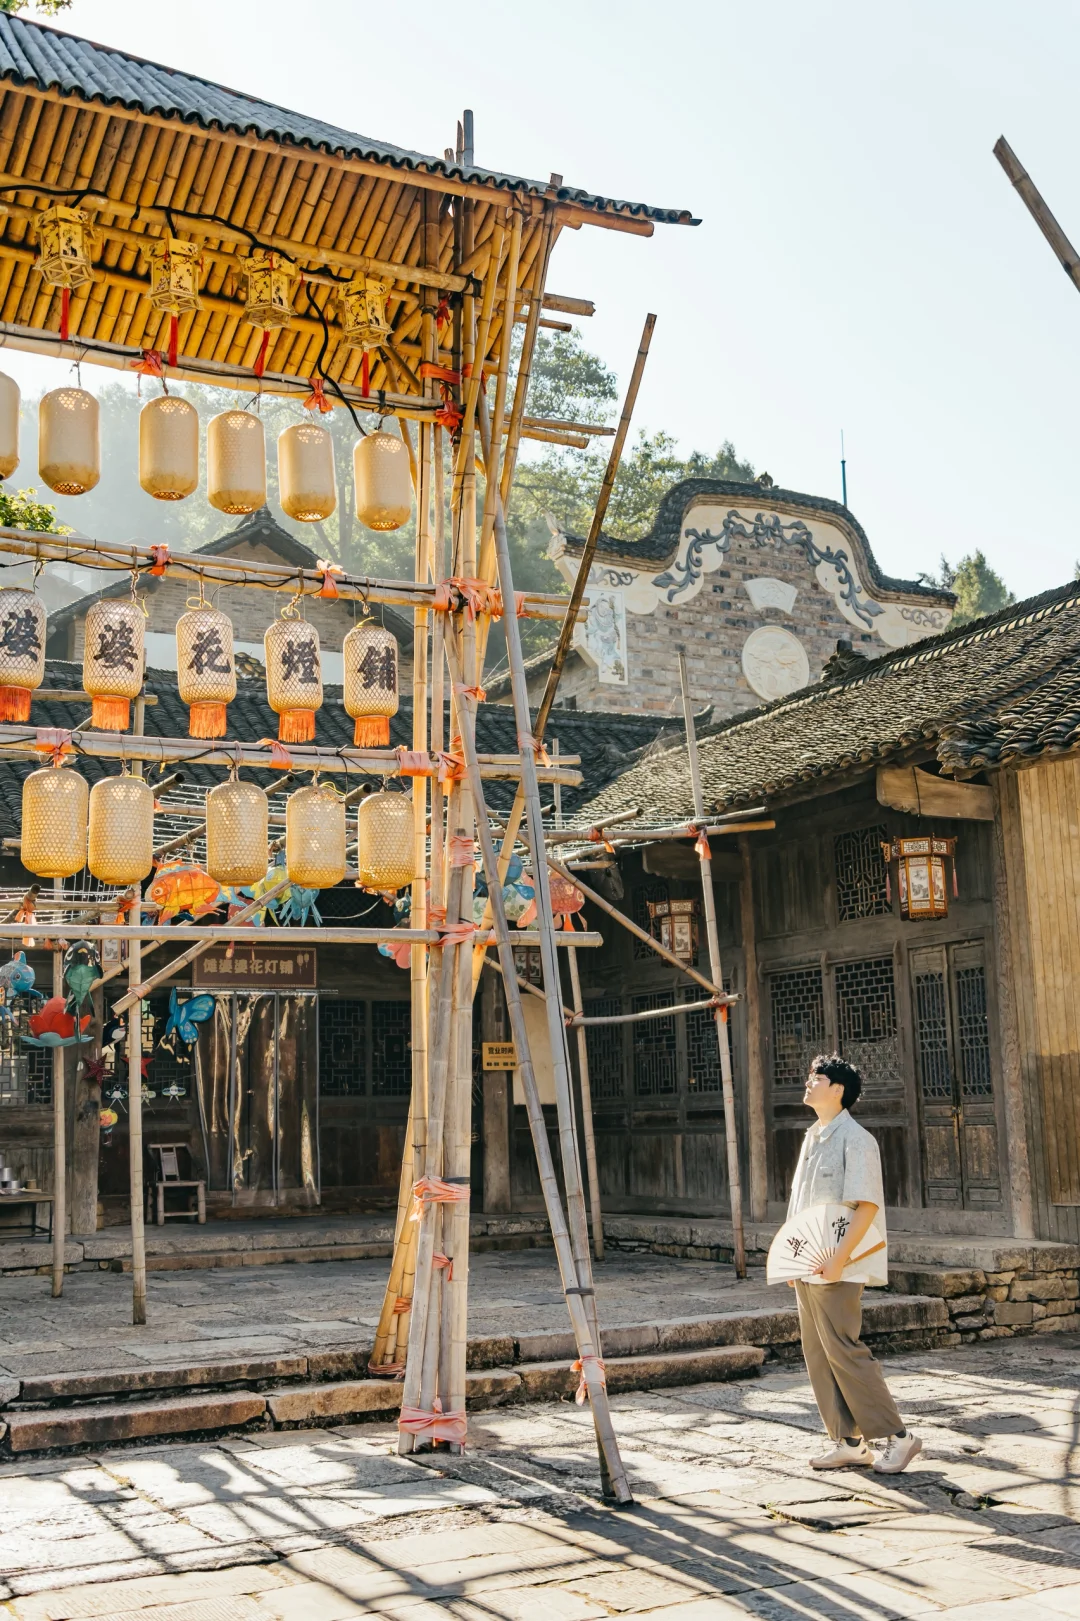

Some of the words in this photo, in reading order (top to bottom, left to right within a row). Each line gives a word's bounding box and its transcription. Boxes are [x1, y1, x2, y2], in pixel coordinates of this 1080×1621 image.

[93, 620, 138, 672] 婆
[187, 628, 231, 675] 花
[281, 638, 319, 685] 燈
[832, 1216, 850, 1243] 常
